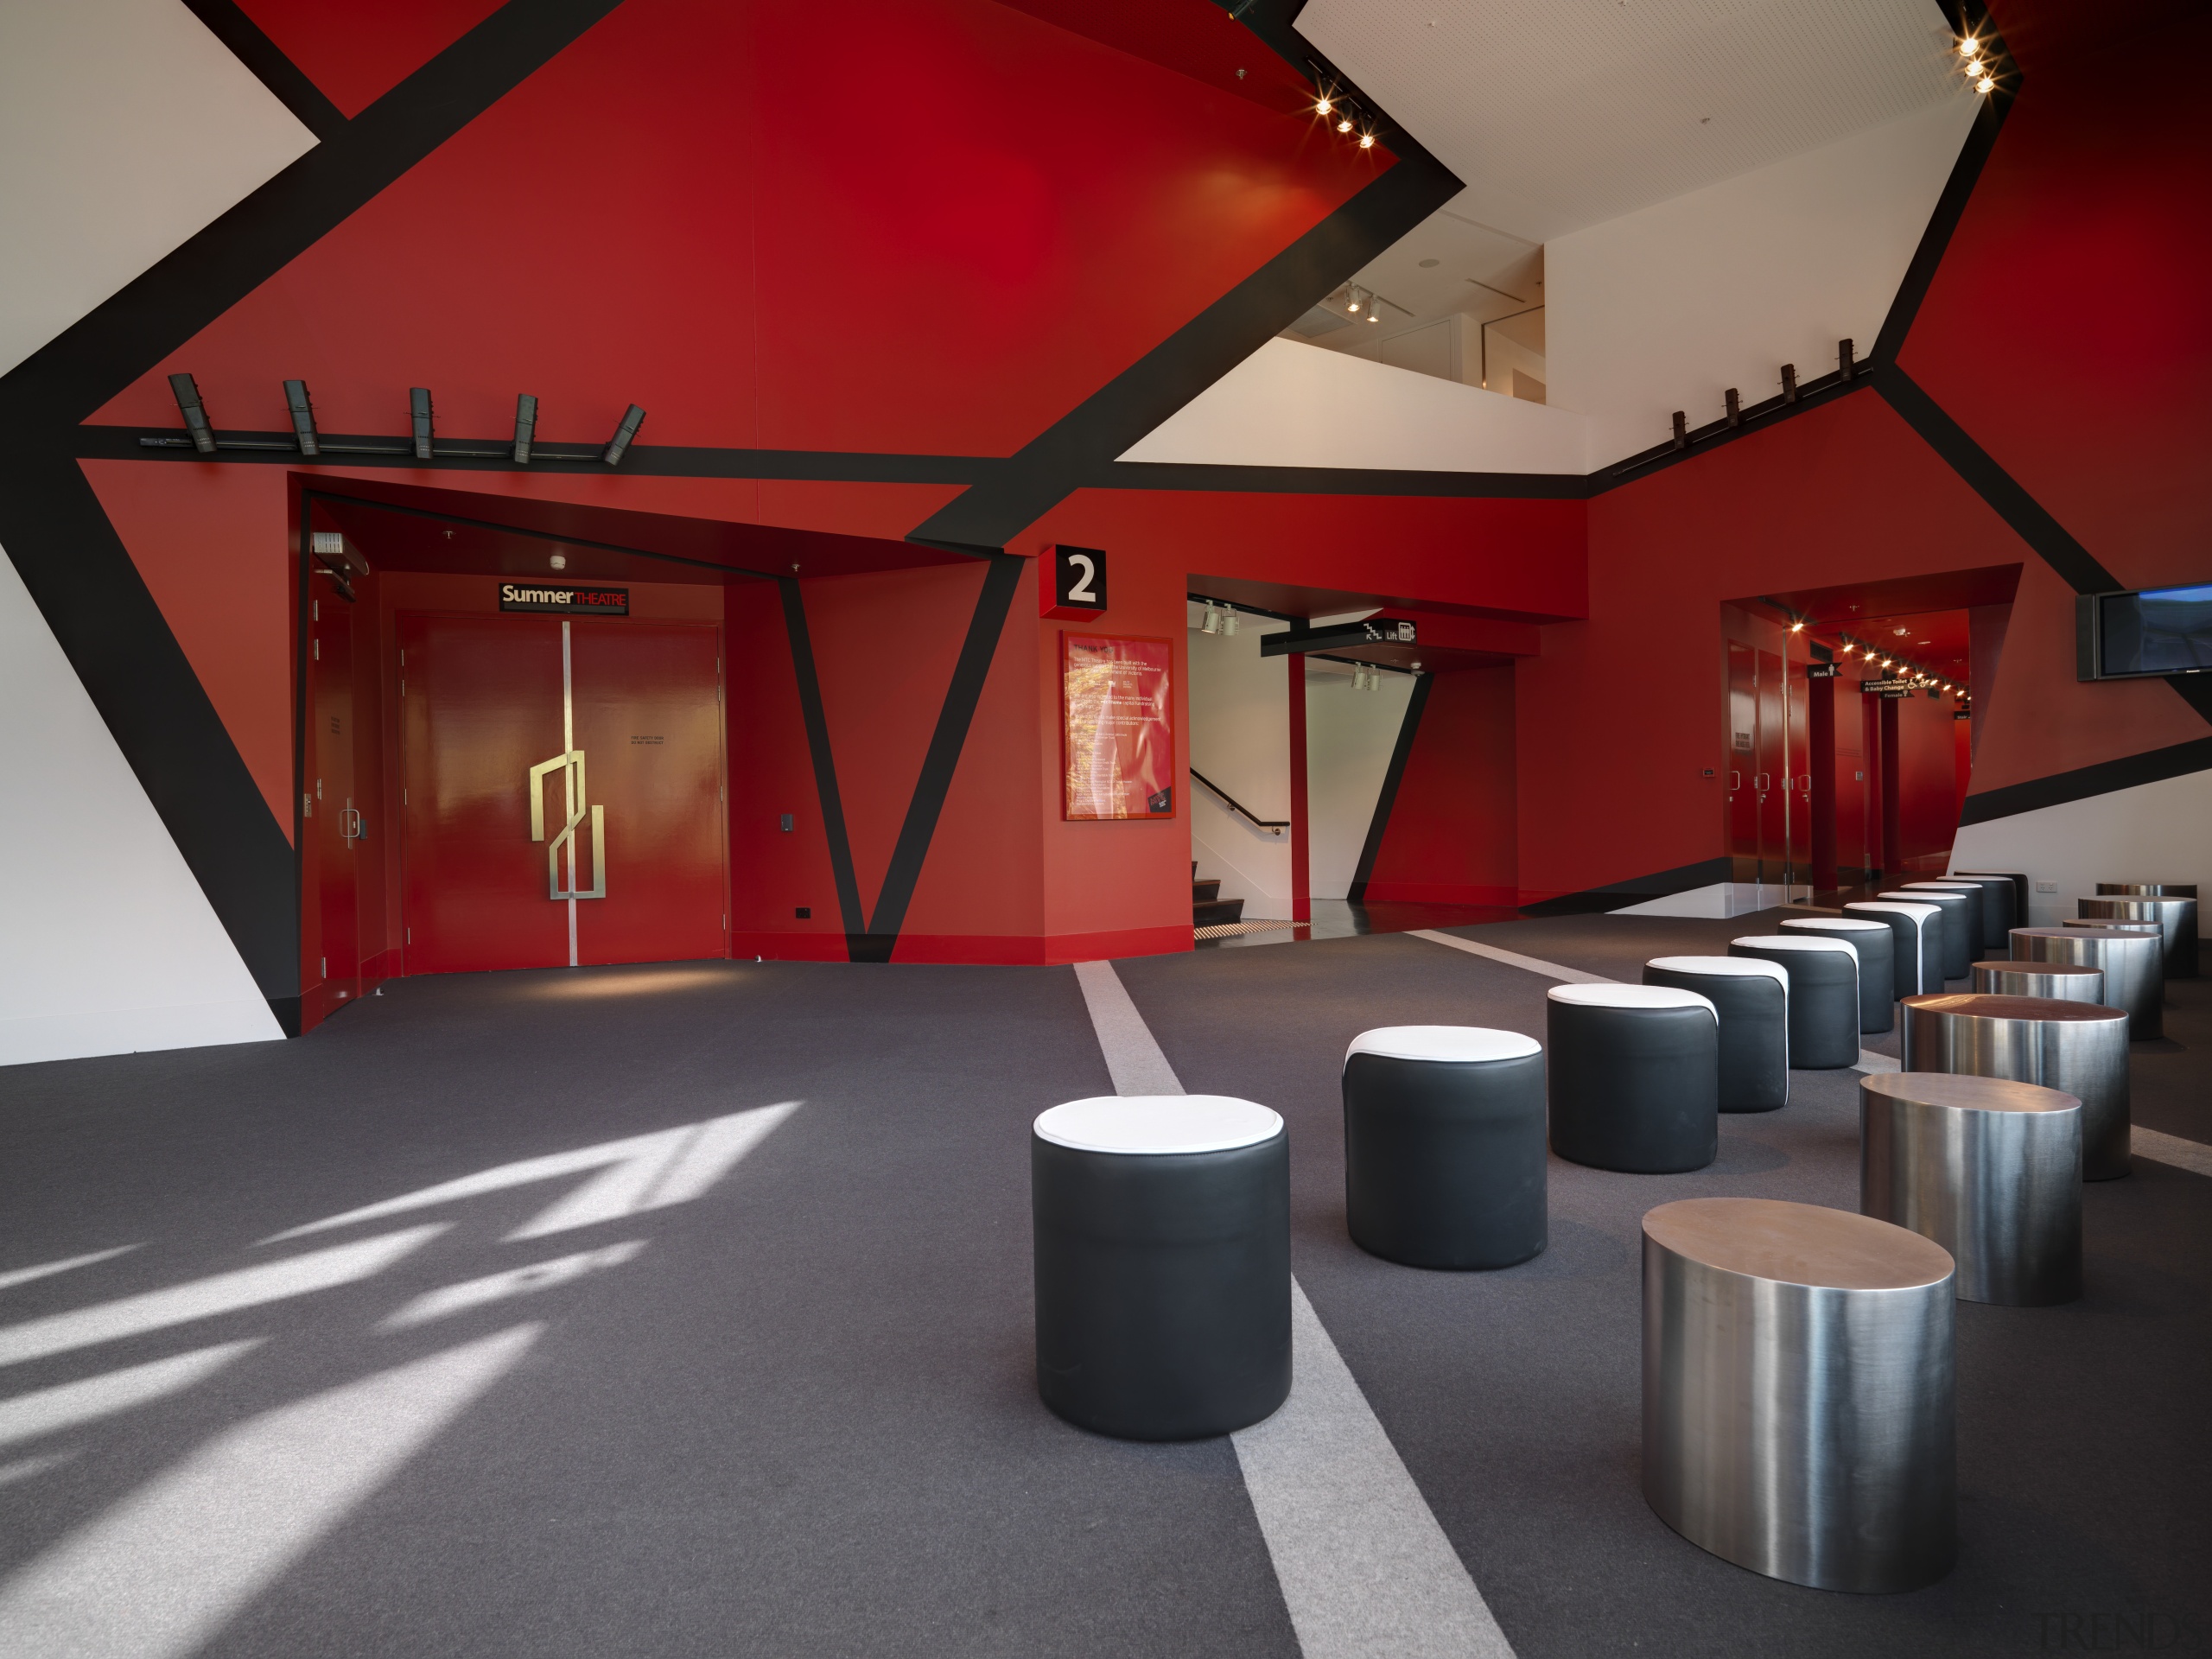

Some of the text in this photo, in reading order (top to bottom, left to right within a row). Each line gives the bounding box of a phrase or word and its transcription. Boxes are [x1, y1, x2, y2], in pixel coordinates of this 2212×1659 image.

[1068, 554, 1096, 602] 2
[502, 585, 626, 606] Sumner THEATRE
[1386, 632, 1398, 640] Lift
